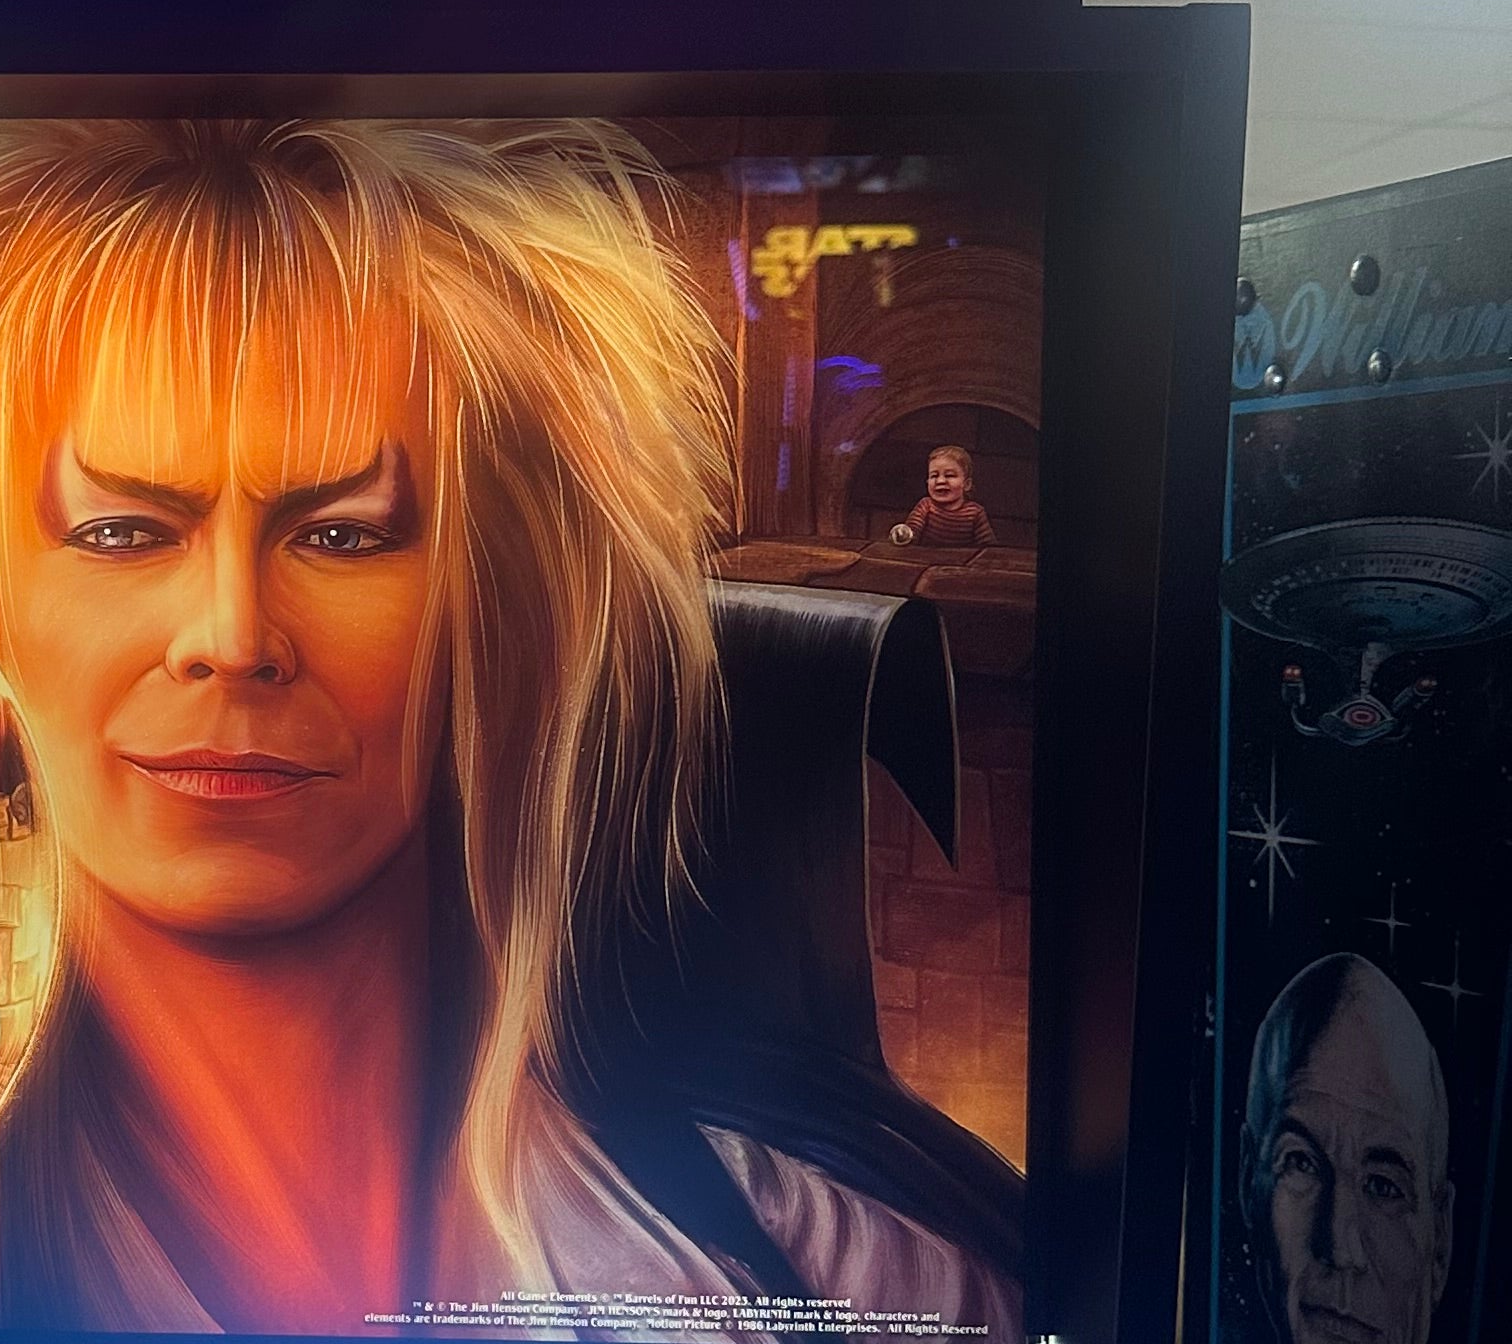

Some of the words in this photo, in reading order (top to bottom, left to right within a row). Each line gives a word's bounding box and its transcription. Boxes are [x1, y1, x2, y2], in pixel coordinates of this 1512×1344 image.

[501, 1291, 514, 1301] All
[518, 1292, 546, 1301] Game
[550, 1292, 597, 1302] Elements
[625, 1294, 662, 1304] Barrels
[665, 1295, 675, 1304] of
[678, 1295, 696, 1305] Fun
[700, 1295, 718, 1305] LLC
[755, 1296, 768, 1306] All
[773, 1297, 803, 1308] rights
[807, 1298, 851, 1308] reserved
[425, 1302, 434, 1312] &
[449, 1302, 467, 1312] The
[469, 1302, 488, 1313] Jim
[492, 1303, 530, 1313] Henson
[663, 1306, 688, 1316] mark
[692, 1307, 701, 1317] &
[733, 1308, 791, 1319] LABYRINTH
[794, 1310, 820, 1320] mark
[824, 1311, 832, 1320] &
[864, 1311, 918, 1322] characters
[921, 1312, 940, 1322] and
[365, 1313, 411, 1323] elements
[414, 1314, 430, 1324] are
[433, 1314, 491, 1325] trademarks
[493, 1315, 505, 1325] of
[507, 1315, 525, 1326] The
[527, 1316, 547, 1326] Jim
[550, 1316, 587, 1327] Henson
[647, 1318, 682, 1329] Motion
[684, 1319, 721, 1330] Picture
[738, 1320, 764, 1330] 1986
[766, 1321, 815, 1333] Labyrinth
[887, 1323, 902, 1333] All
[904, 1324, 938, 1335] Rights
[941, 1325, 988, 1334] Reserved
